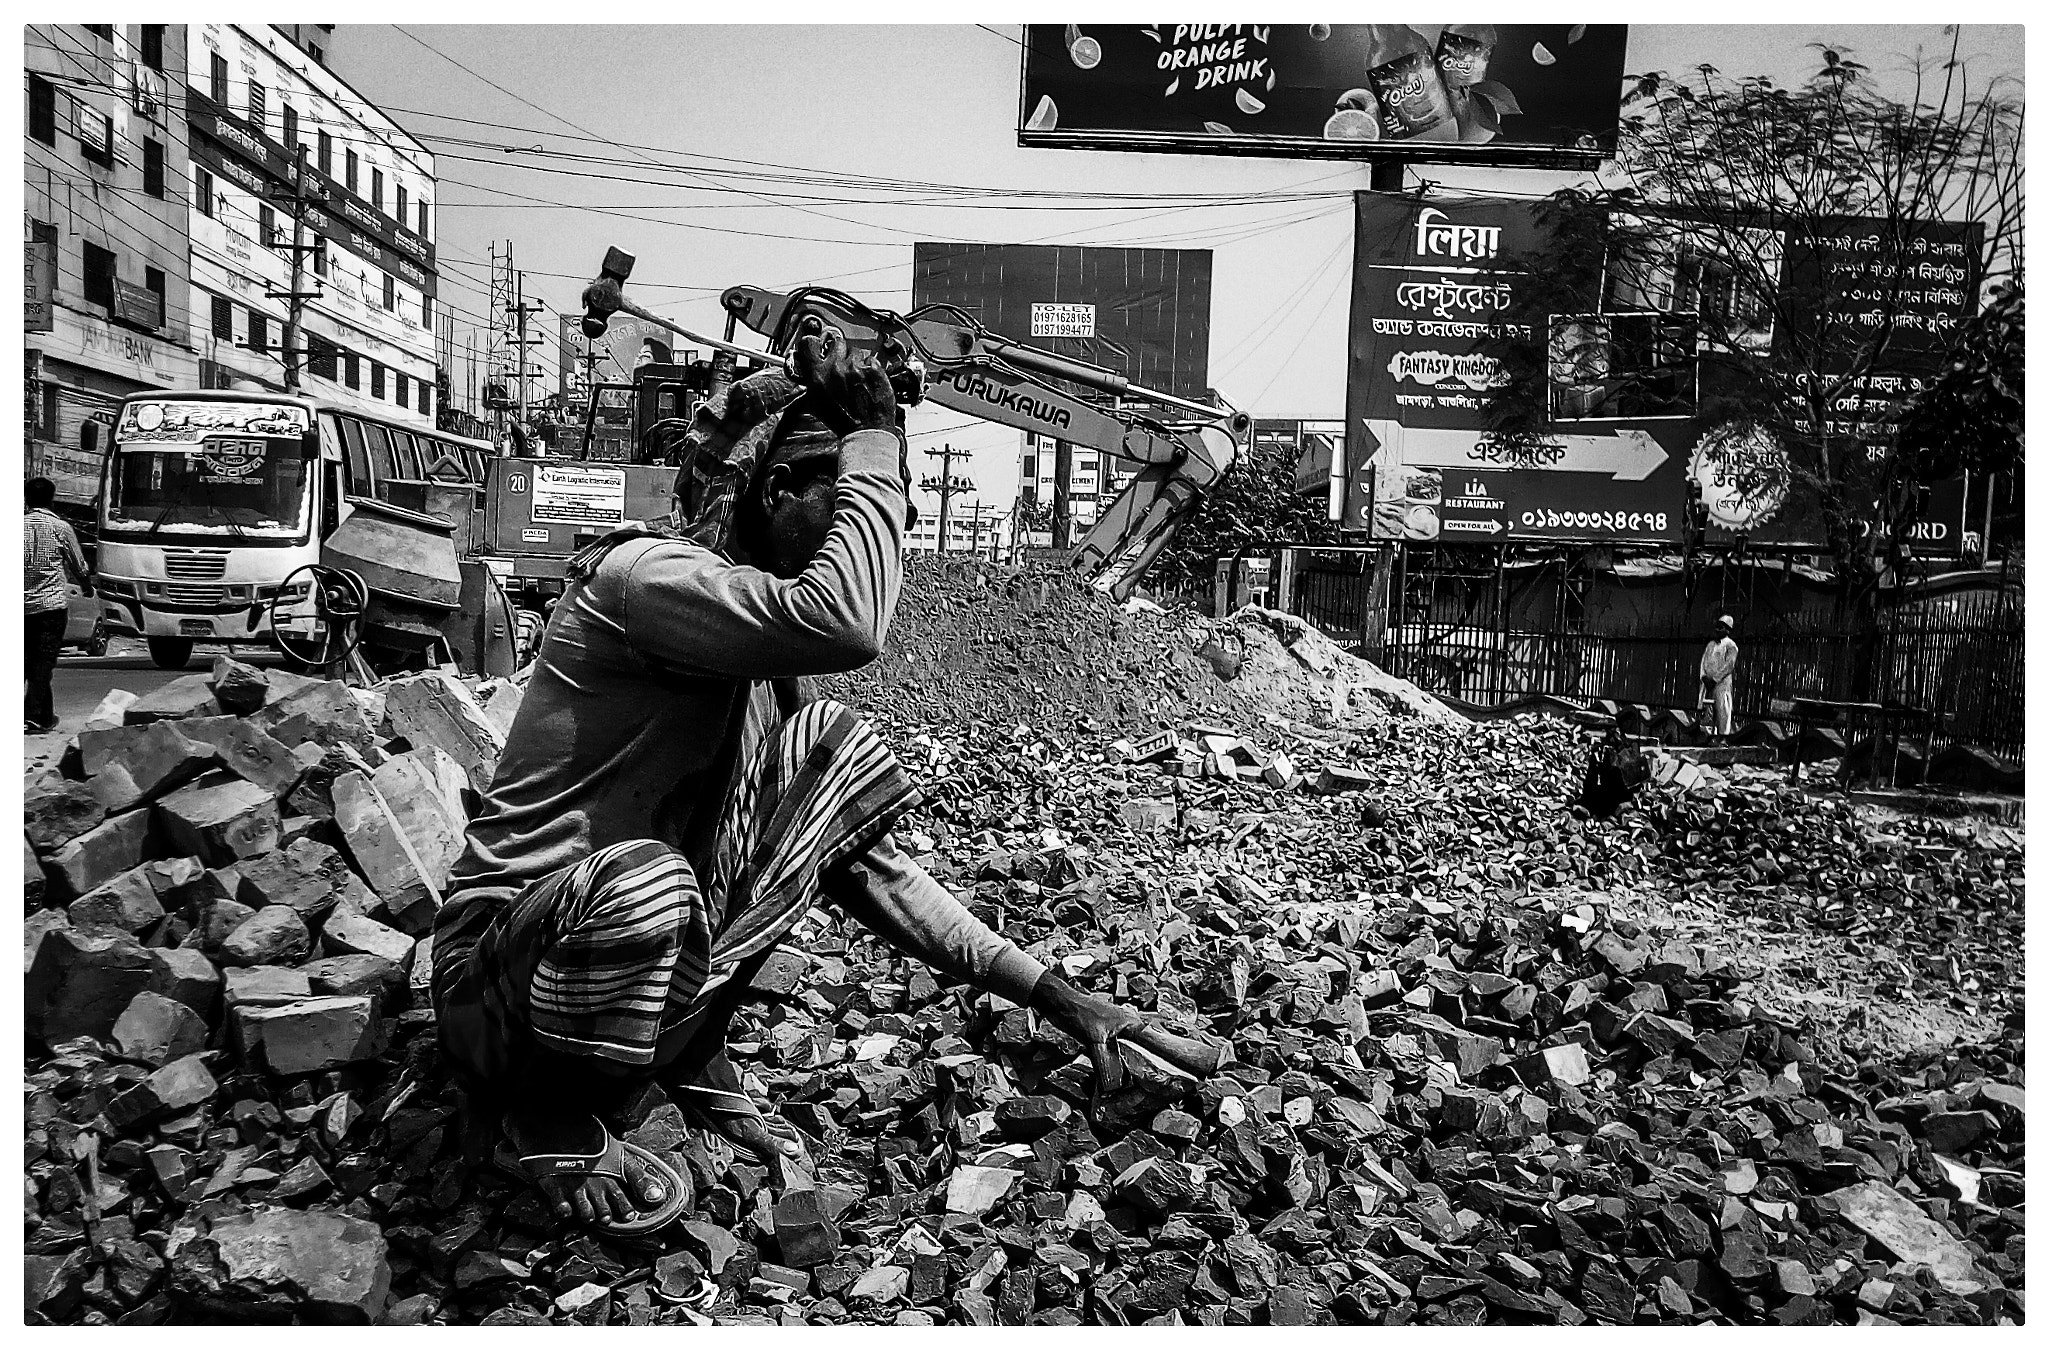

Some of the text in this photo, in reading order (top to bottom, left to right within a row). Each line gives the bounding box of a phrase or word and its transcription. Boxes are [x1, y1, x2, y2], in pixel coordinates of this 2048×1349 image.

[1157, 38, 1247, 71] ORANGE
[1195, 57, 1268, 90] DRINK
[1413, 207, 1502, 261] লিয়া
[1034, 313, 1093, 324] 01971628165
[1033, 324, 1093, 336] 01971994477
[124, 336, 154, 367] BANK
[1400, 356, 1449, 374] FANTASY
[937, 369, 1072, 430] FURUKAWA
[511, 475, 525, 492] 20
[552, 474, 567, 483] Earth
[1445, 499, 1505, 510] RESTAURANT
[1467, 522, 1482, 530] FOR
[1521, 509, 1668, 532] ০১৯৩৩৩২৪৫৭৪
